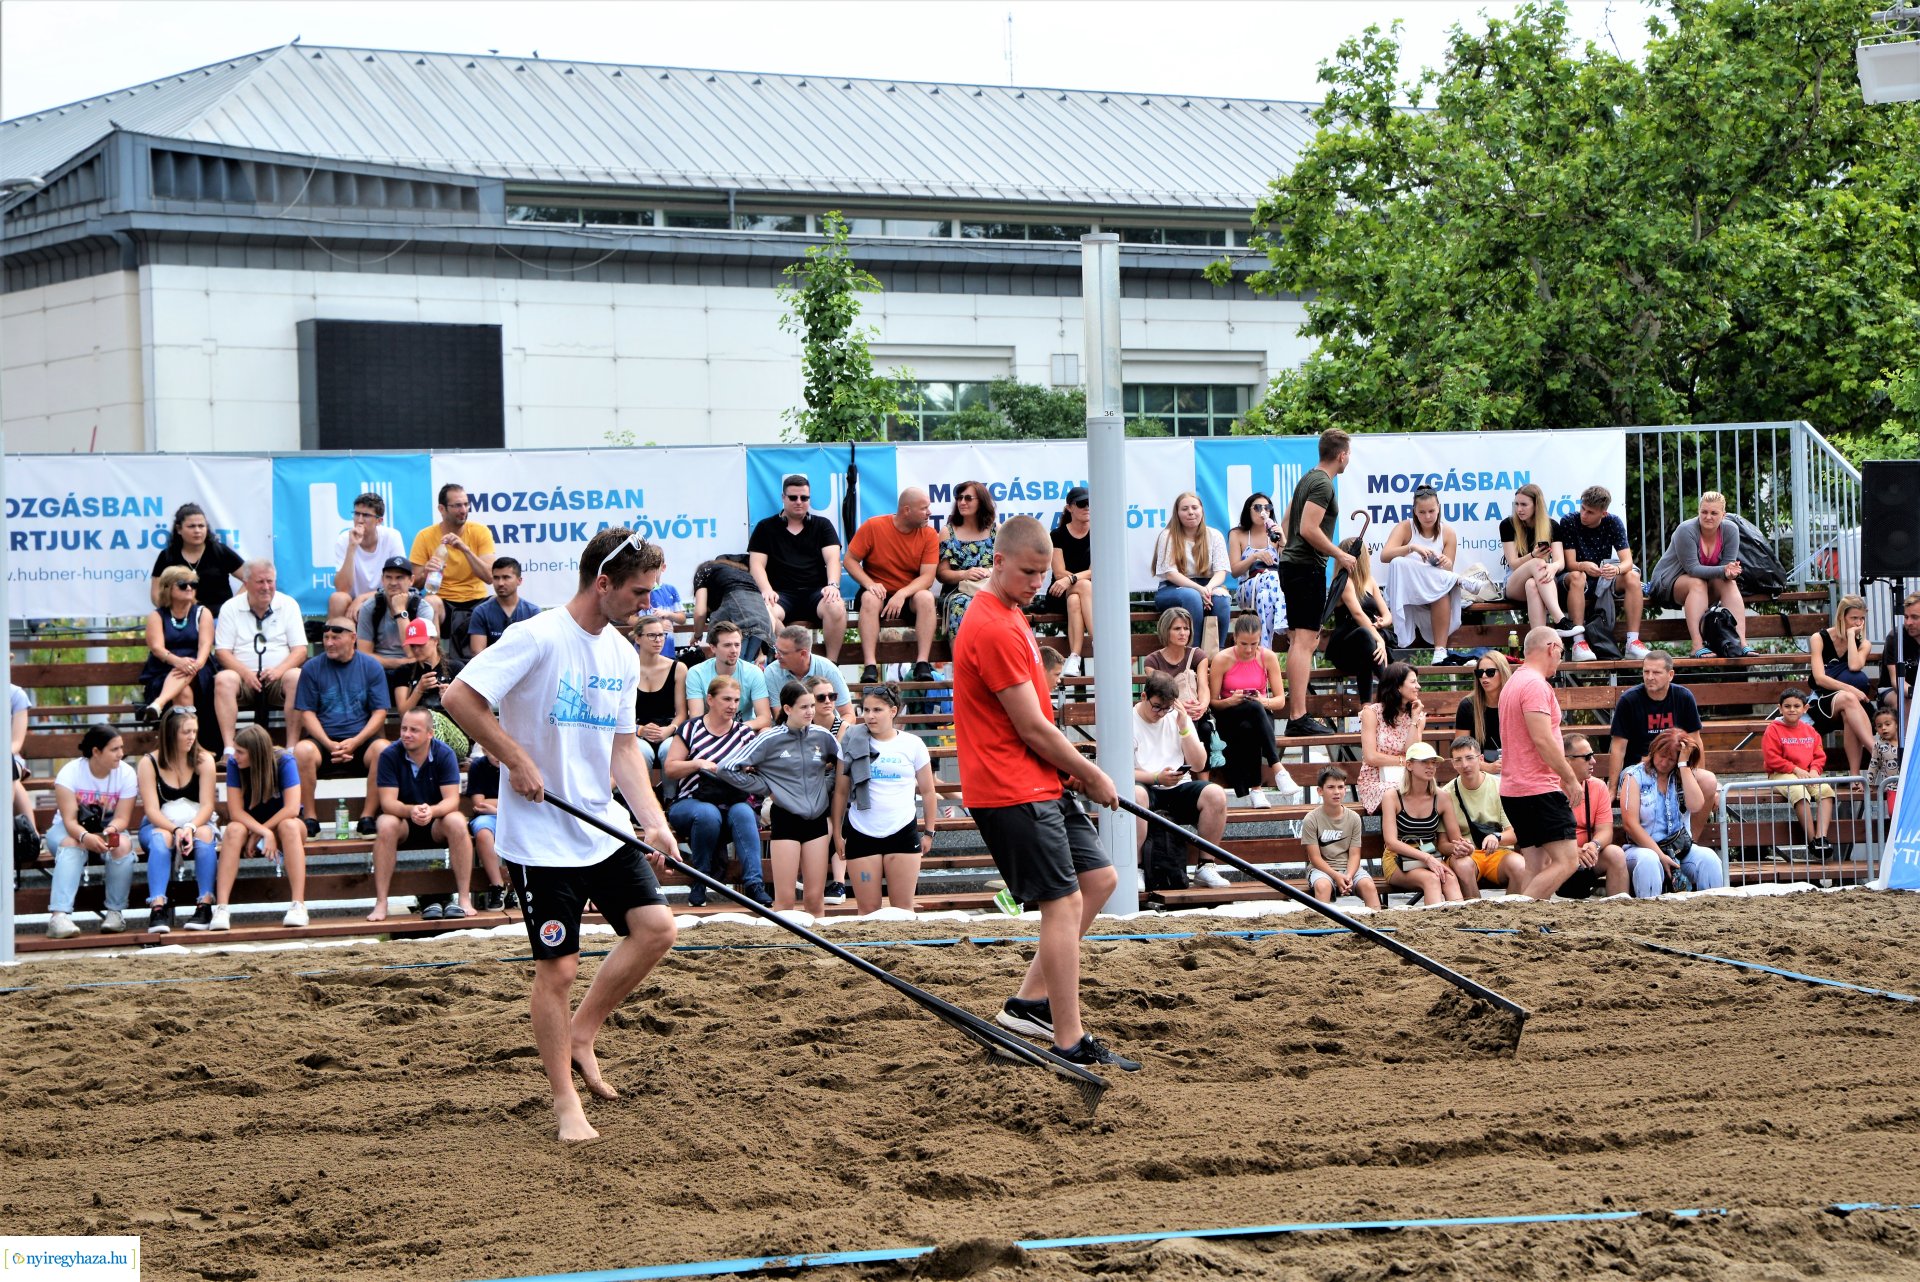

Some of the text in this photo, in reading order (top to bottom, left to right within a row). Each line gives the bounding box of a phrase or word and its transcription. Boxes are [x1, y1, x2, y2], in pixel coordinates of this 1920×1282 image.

[929, 477, 1089, 503] MGÁSBA
[1367, 468, 1531, 493] MOZGÁSBAN
[5, 492, 163, 519] OZGÁSBAN
[468, 486, 644, 512] MOZGÁSBAN
[1126, 504, 1167, 529] ŐT!
[1368, 502, 1480, 524] TARUK
[1484, 502, 1503, 521] A
[10, 523, 241, 551] RTJUK A JÖT!
[487, 522, 588, 544] ARTJUK
[1647, 712, 1674, 730] HH
[1320, 829, 1344, 841] NIKE
